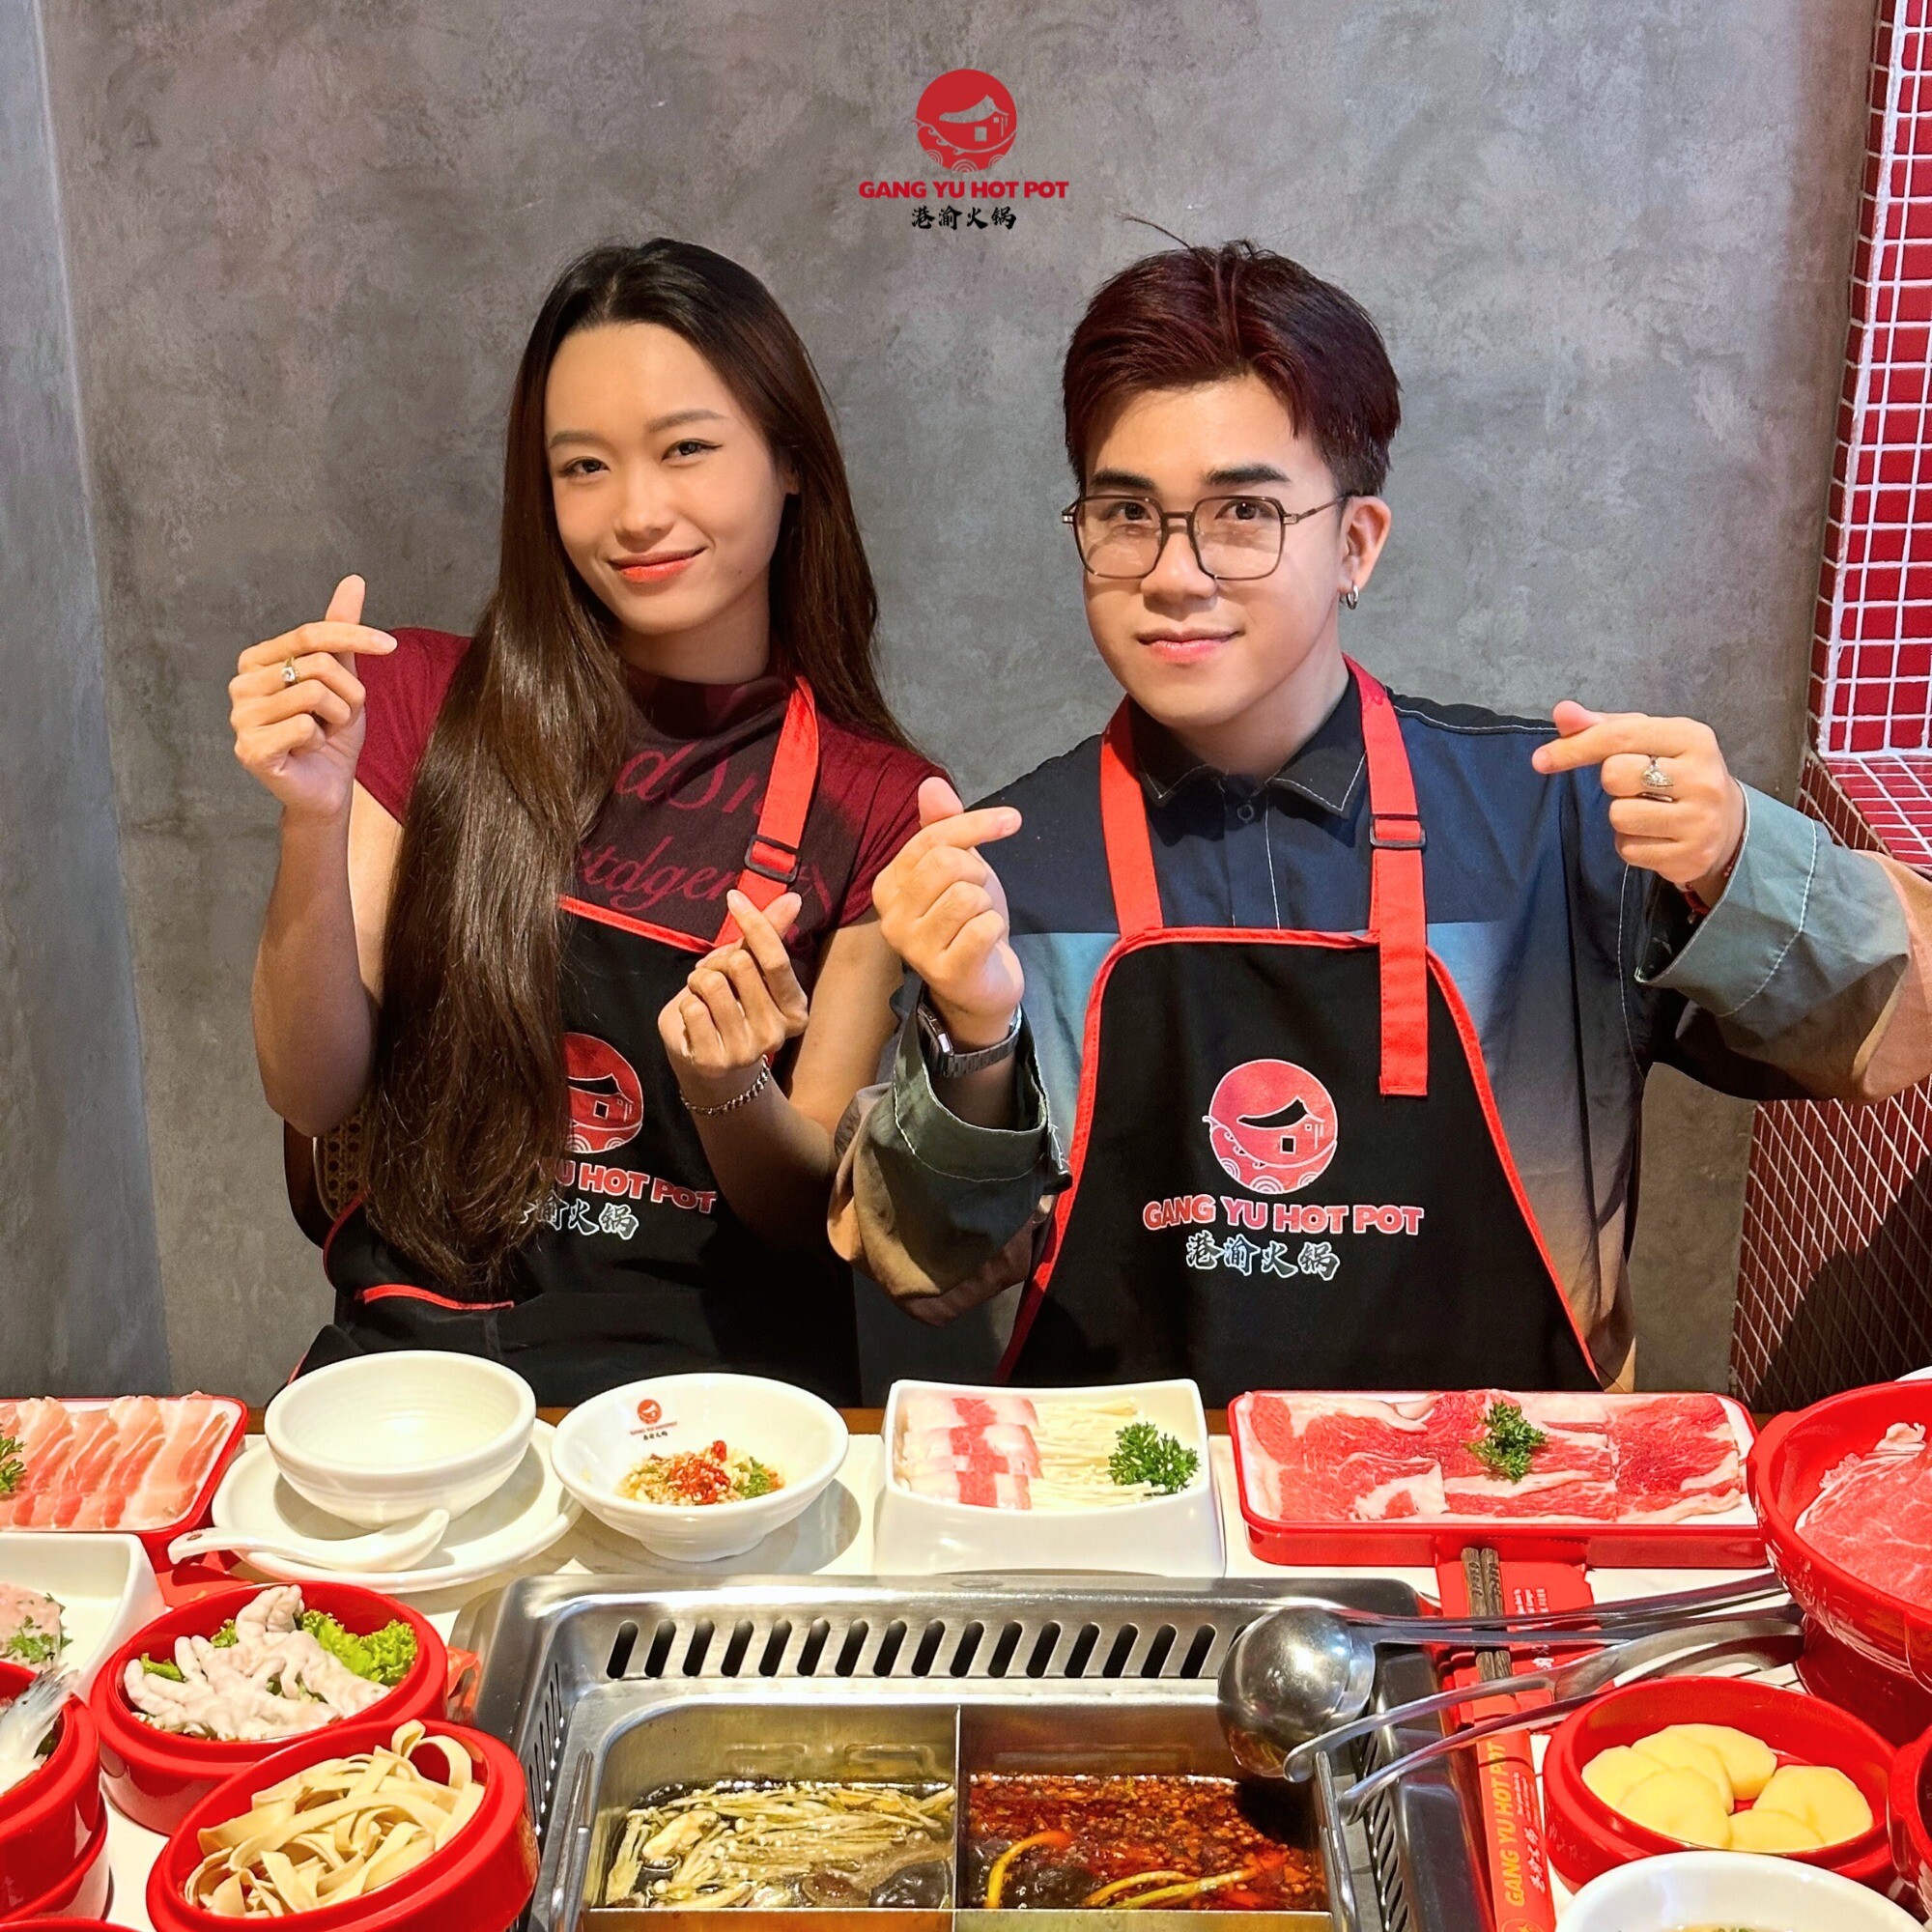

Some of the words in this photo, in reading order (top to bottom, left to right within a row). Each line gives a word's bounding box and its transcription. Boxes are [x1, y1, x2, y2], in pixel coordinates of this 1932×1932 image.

[579, 1163, 650, 1200] HOT
[651, 1178, 718, 1214] POT
[1143, 1194, 1216, 1231] GANG
[1220, 1196, 1267, 1231] YU
[1273, 1204, 1350, 1234] HOT
[1352, 1205, 1424, 1236] POT
[1186, 1230, 1340, 1281] 港渝火锅
[1486, 1741, 1509, 1776] POT
[1491, 1776, 1514, 1817] HOT
[1495, 1818, 1518, 1845] YU
[1499, 1848, 1525, 1907] GANG
